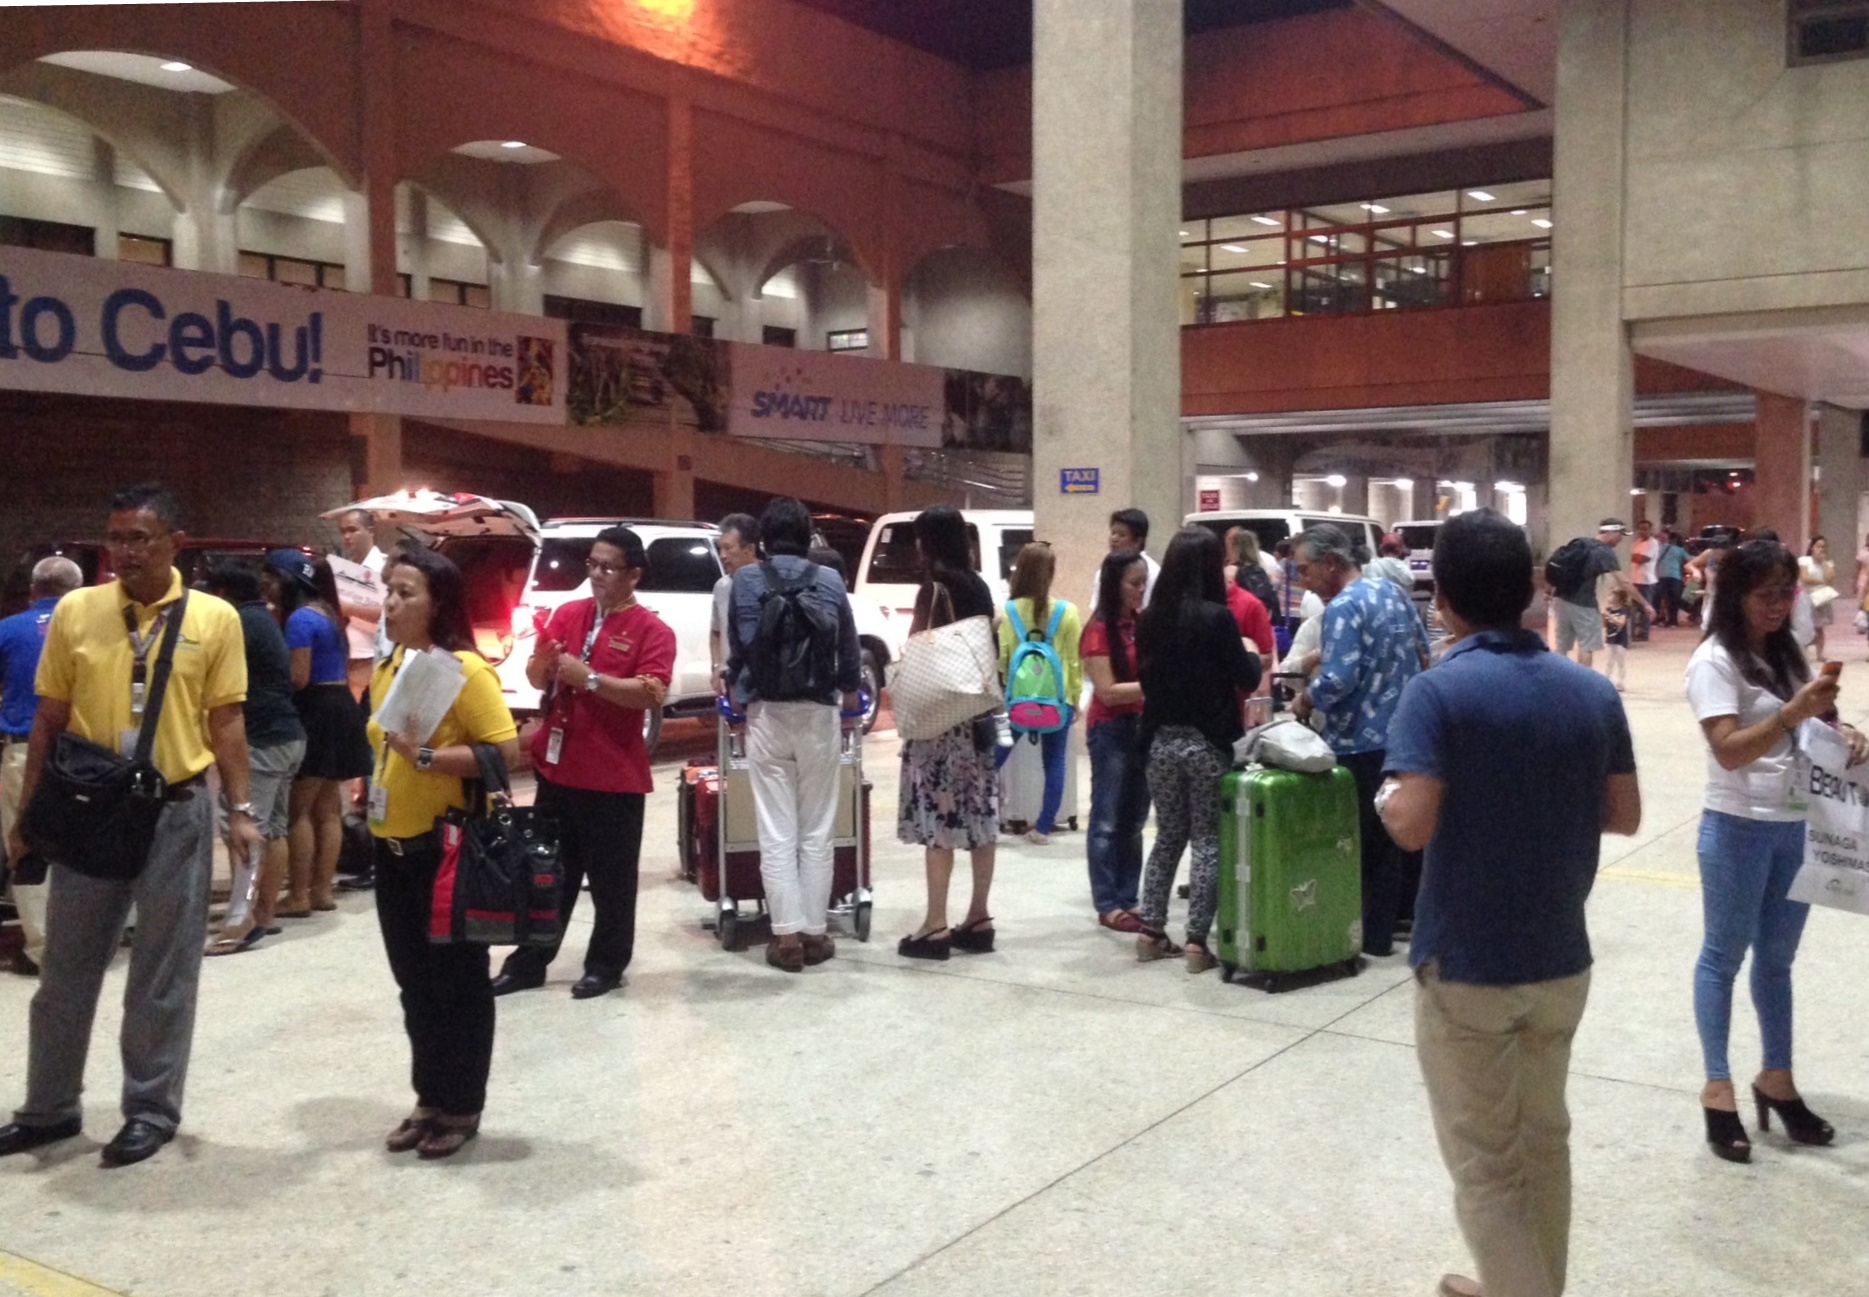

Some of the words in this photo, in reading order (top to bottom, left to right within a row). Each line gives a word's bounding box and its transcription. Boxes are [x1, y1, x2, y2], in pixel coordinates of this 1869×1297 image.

[0, 273, 76, 363] to
[102, 288, 323, 384] Cebu!
[368, 324, 391, 345] It's
[394, 330, 439, 349] more
[442, 333, 468, 353] fun
[470, 335, 485, 353] in
[488, 337, 514, 358] the
[369, 346, 514, 393] Philippines
[750, 391, 832, 422] SMART
[840, 399, 877, 426] LIVE
[884, 402, 929, 430] MORE
[1063, 470, 1096, 482] TAXI
[1808, 829, 1858, 852] SUNAGA
